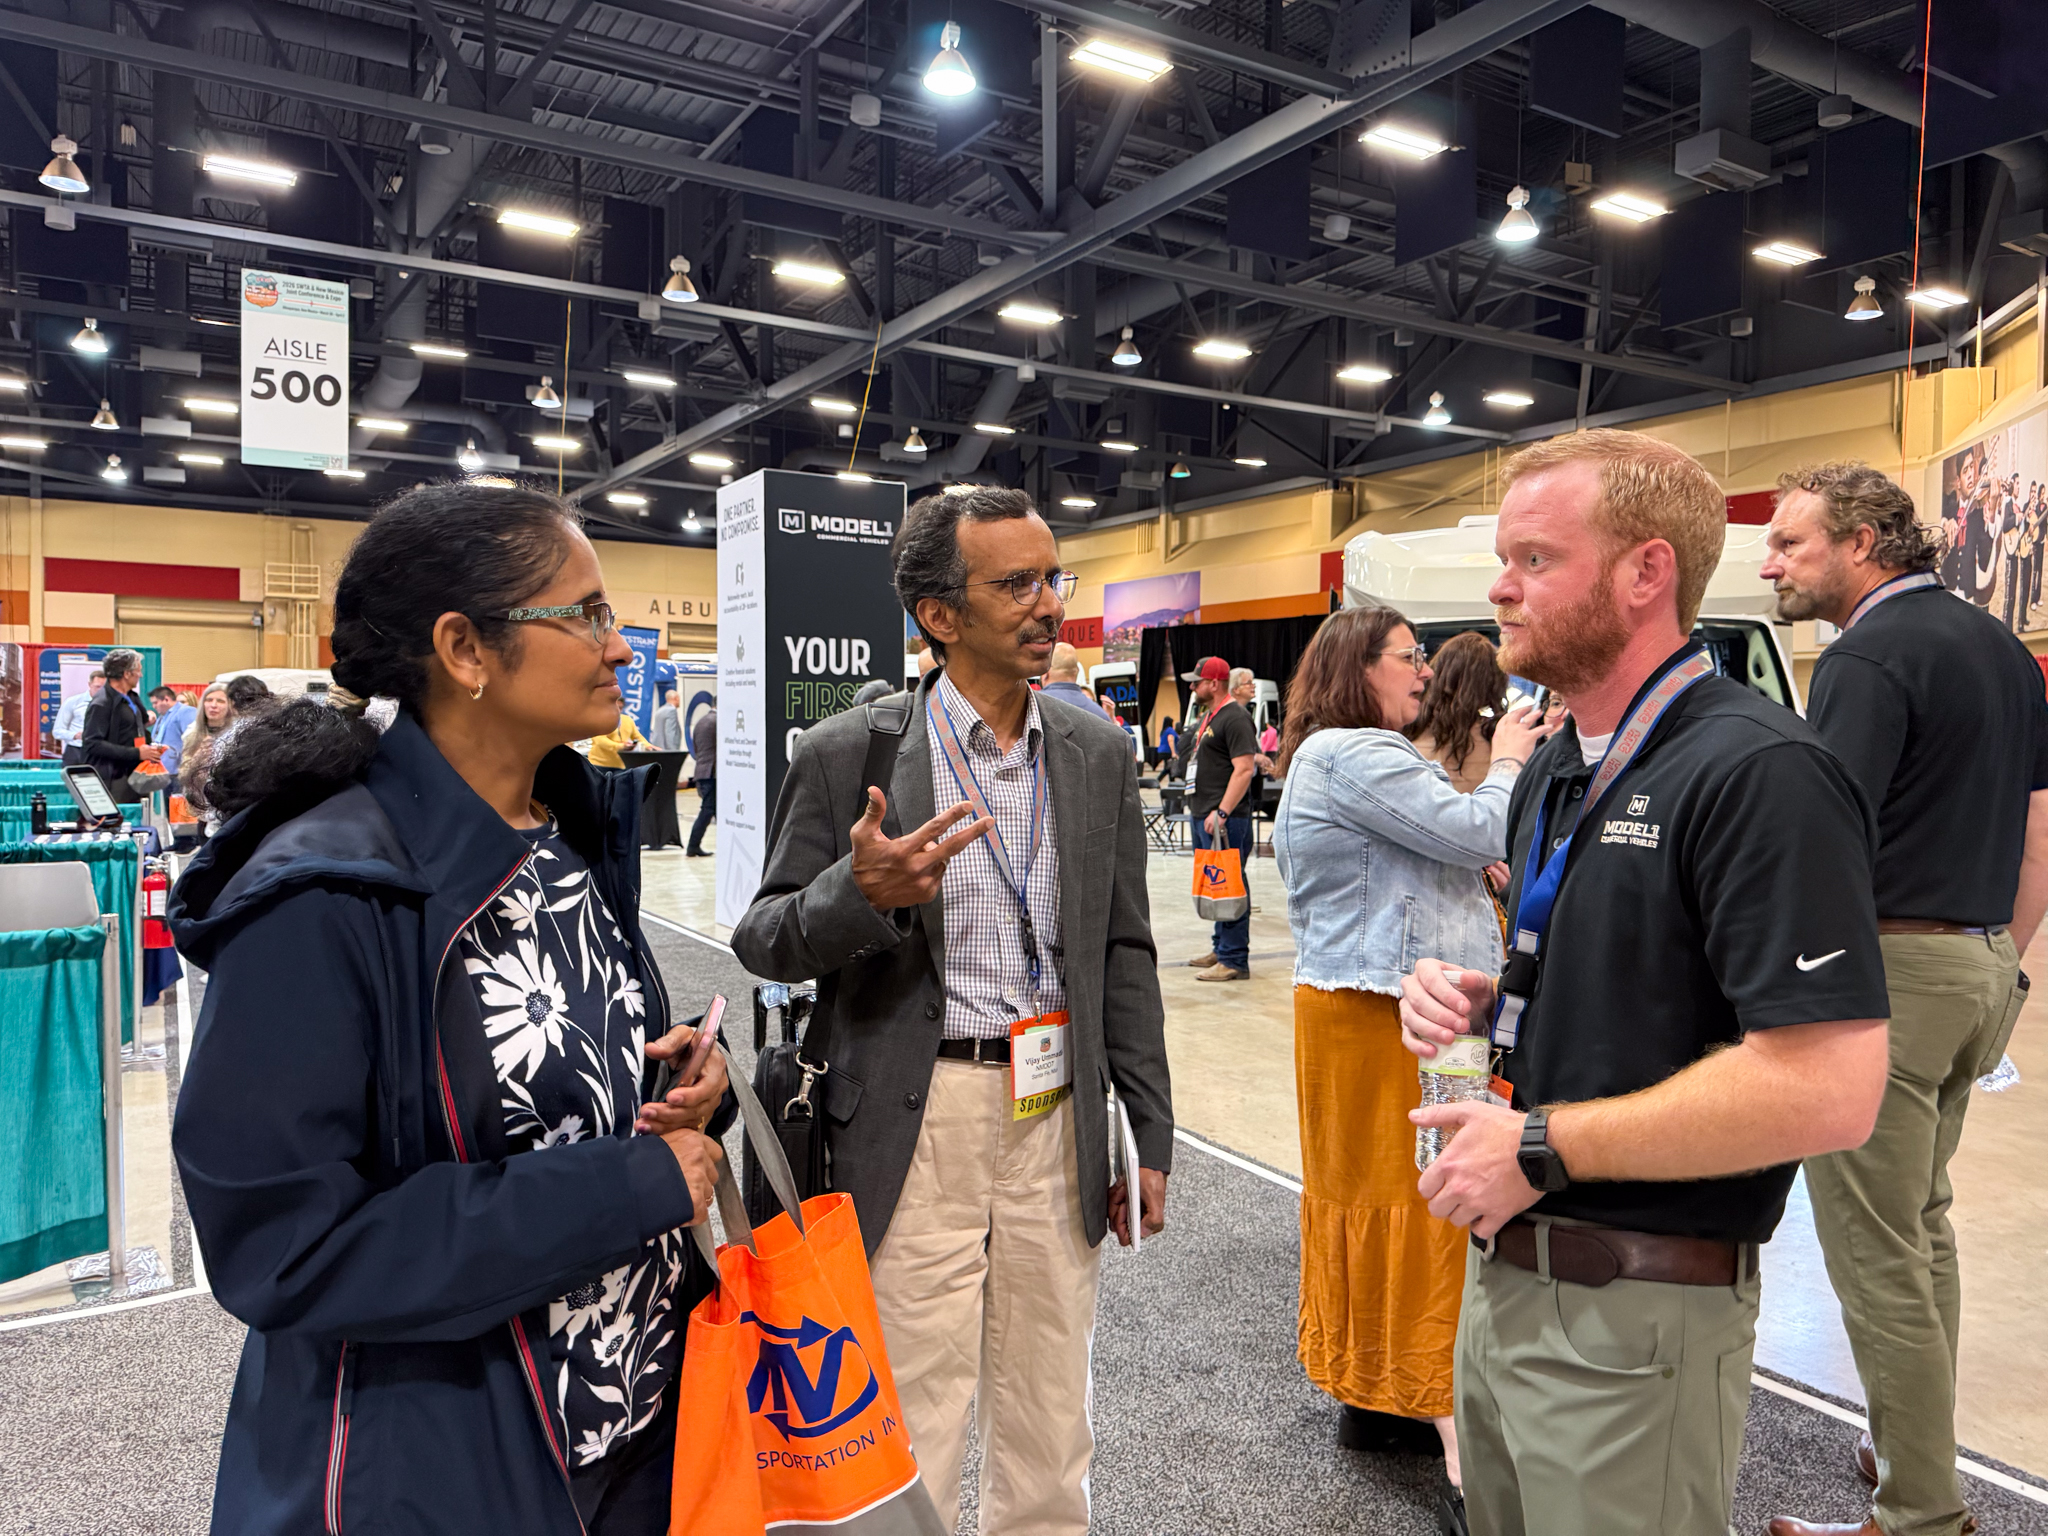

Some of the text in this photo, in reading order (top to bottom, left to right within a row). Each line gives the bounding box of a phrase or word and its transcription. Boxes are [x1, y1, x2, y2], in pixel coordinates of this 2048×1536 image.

[264, 337, 327, 361] AISLE
[250, 366, 342, 407] 500
[810, 514, 894, 537] MODEL1
[816, 533, 889, 545] COMMERCIAL VEHICLES
[784, 635, 871, 676] YOUR
[623, 651, 646, 723] Q'STRA
[1602, 820, 1660, 840] MODEL1
[1025, 1056, 1041, 1067] Vijay
[756, 1429, 875, 1471] SPORTATION
